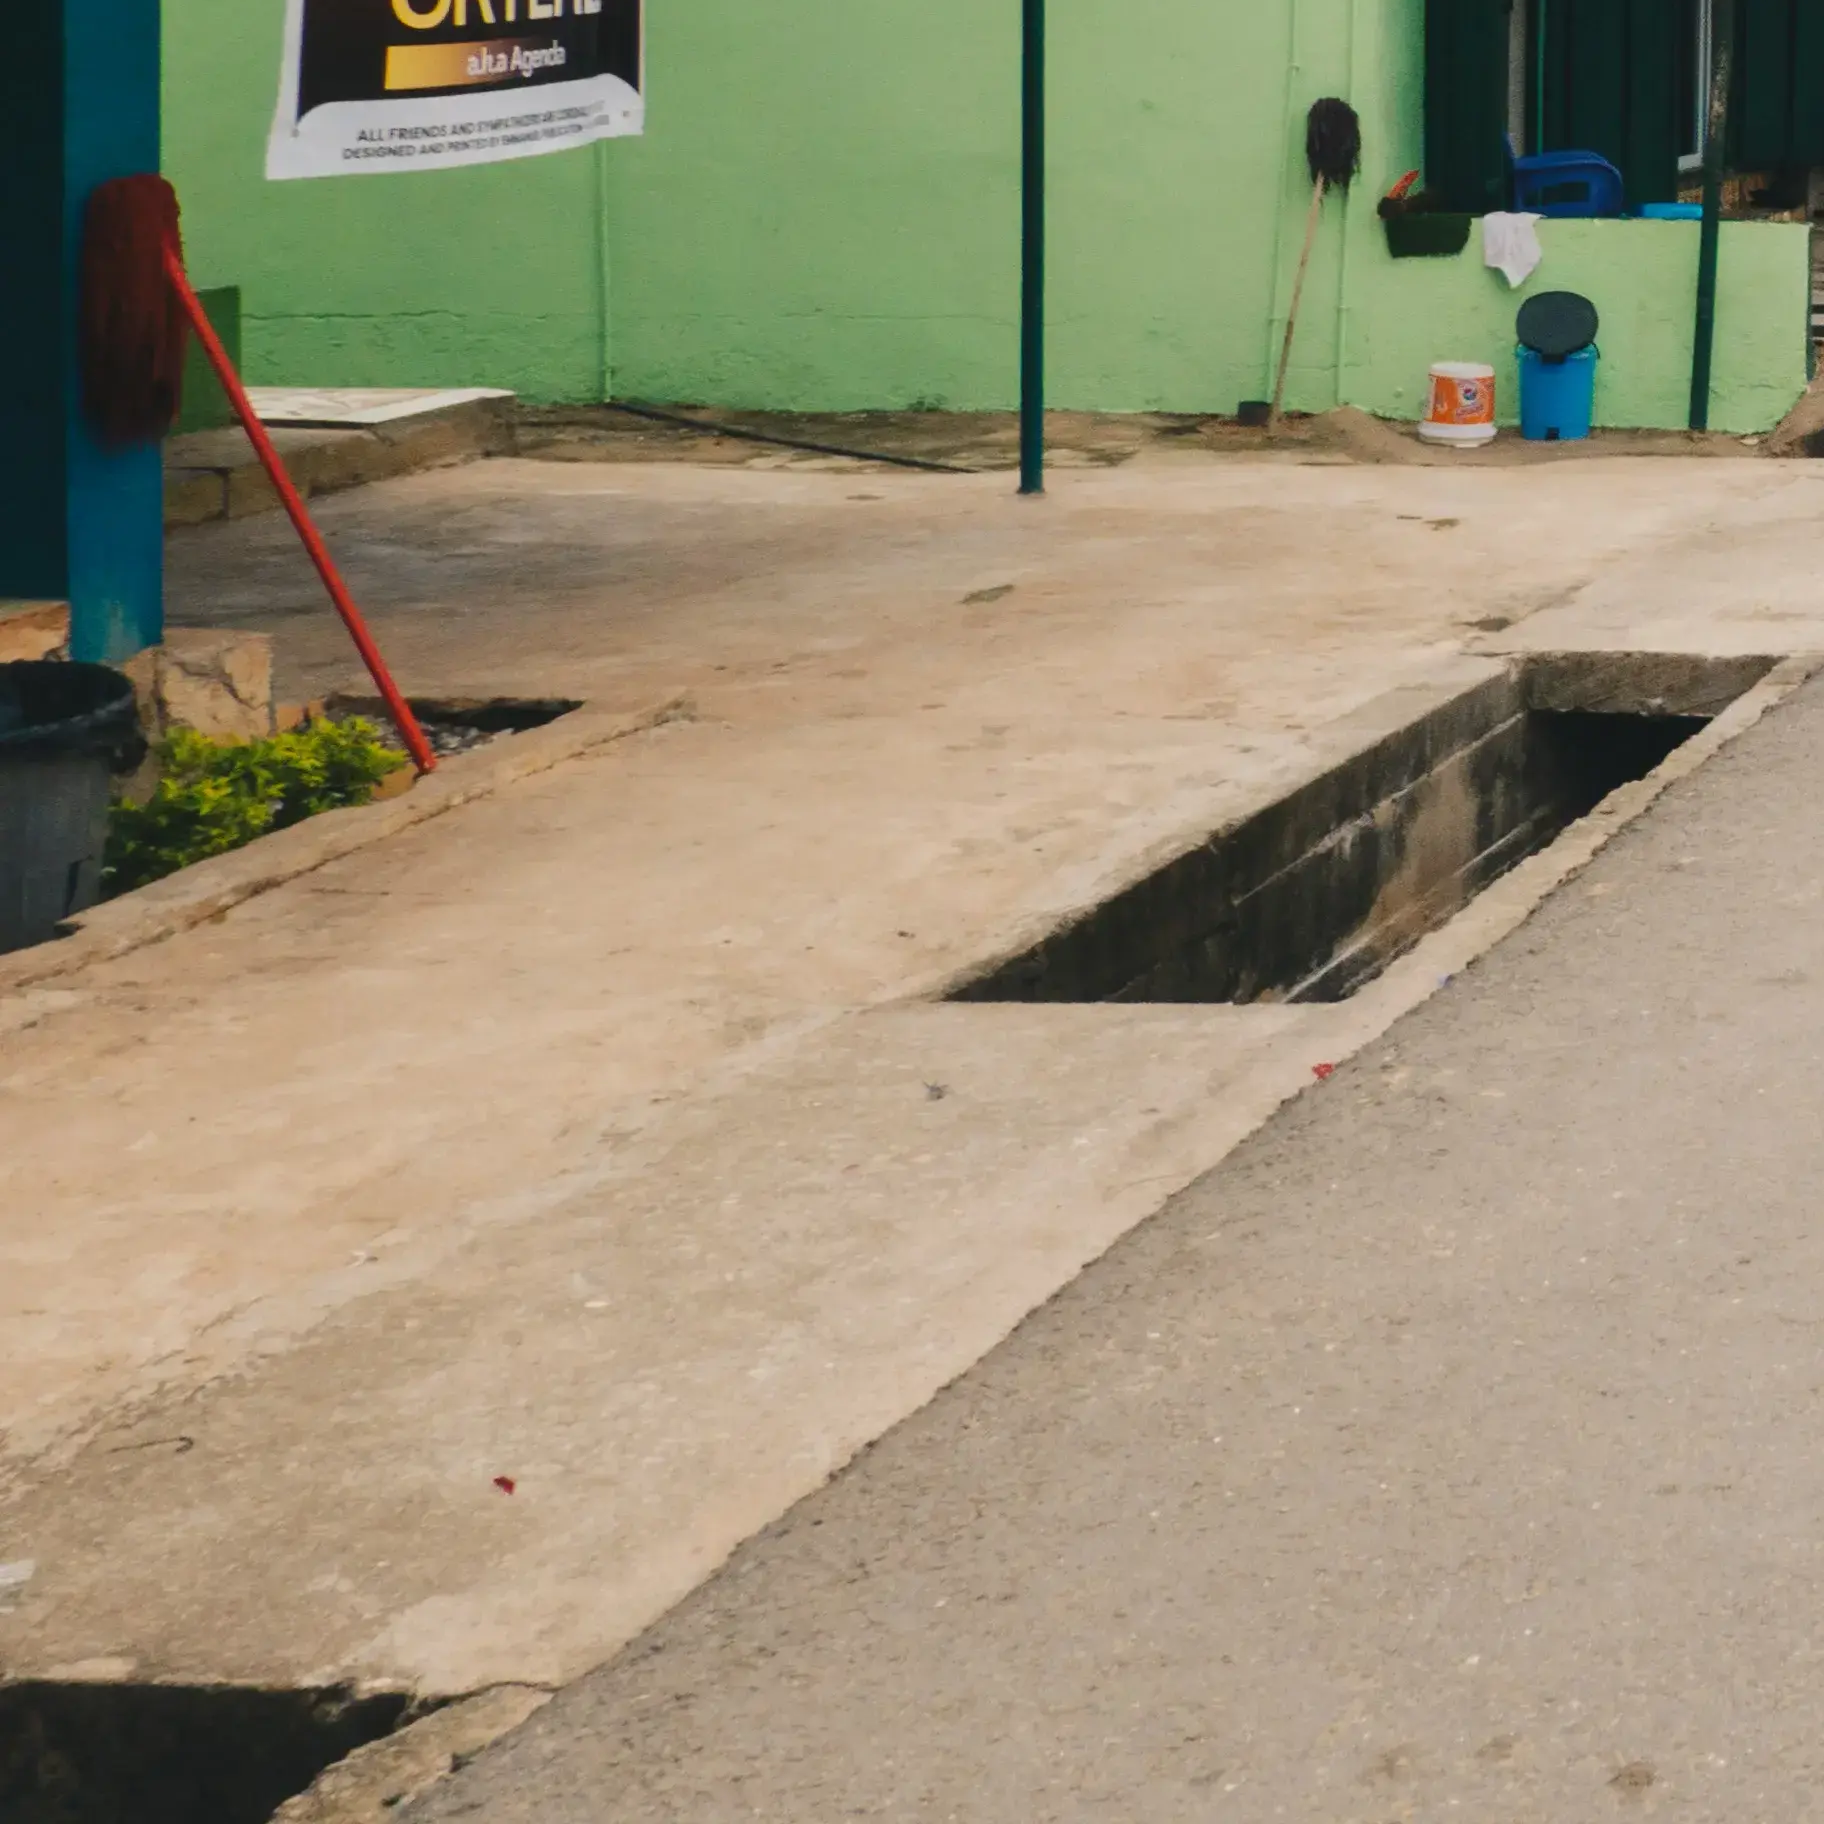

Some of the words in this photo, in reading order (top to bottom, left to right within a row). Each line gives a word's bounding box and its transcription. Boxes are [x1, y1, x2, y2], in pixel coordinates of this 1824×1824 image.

[509, 39, 566, 78] Agenda
[357, 128, 384, 142] ALL
[388, 125, 448, 141] FRIENDS
[451, 122, 475, 136] AND
[343, 144, 416, 160] DESIGNED
[419, 142, 446, 155] AND
